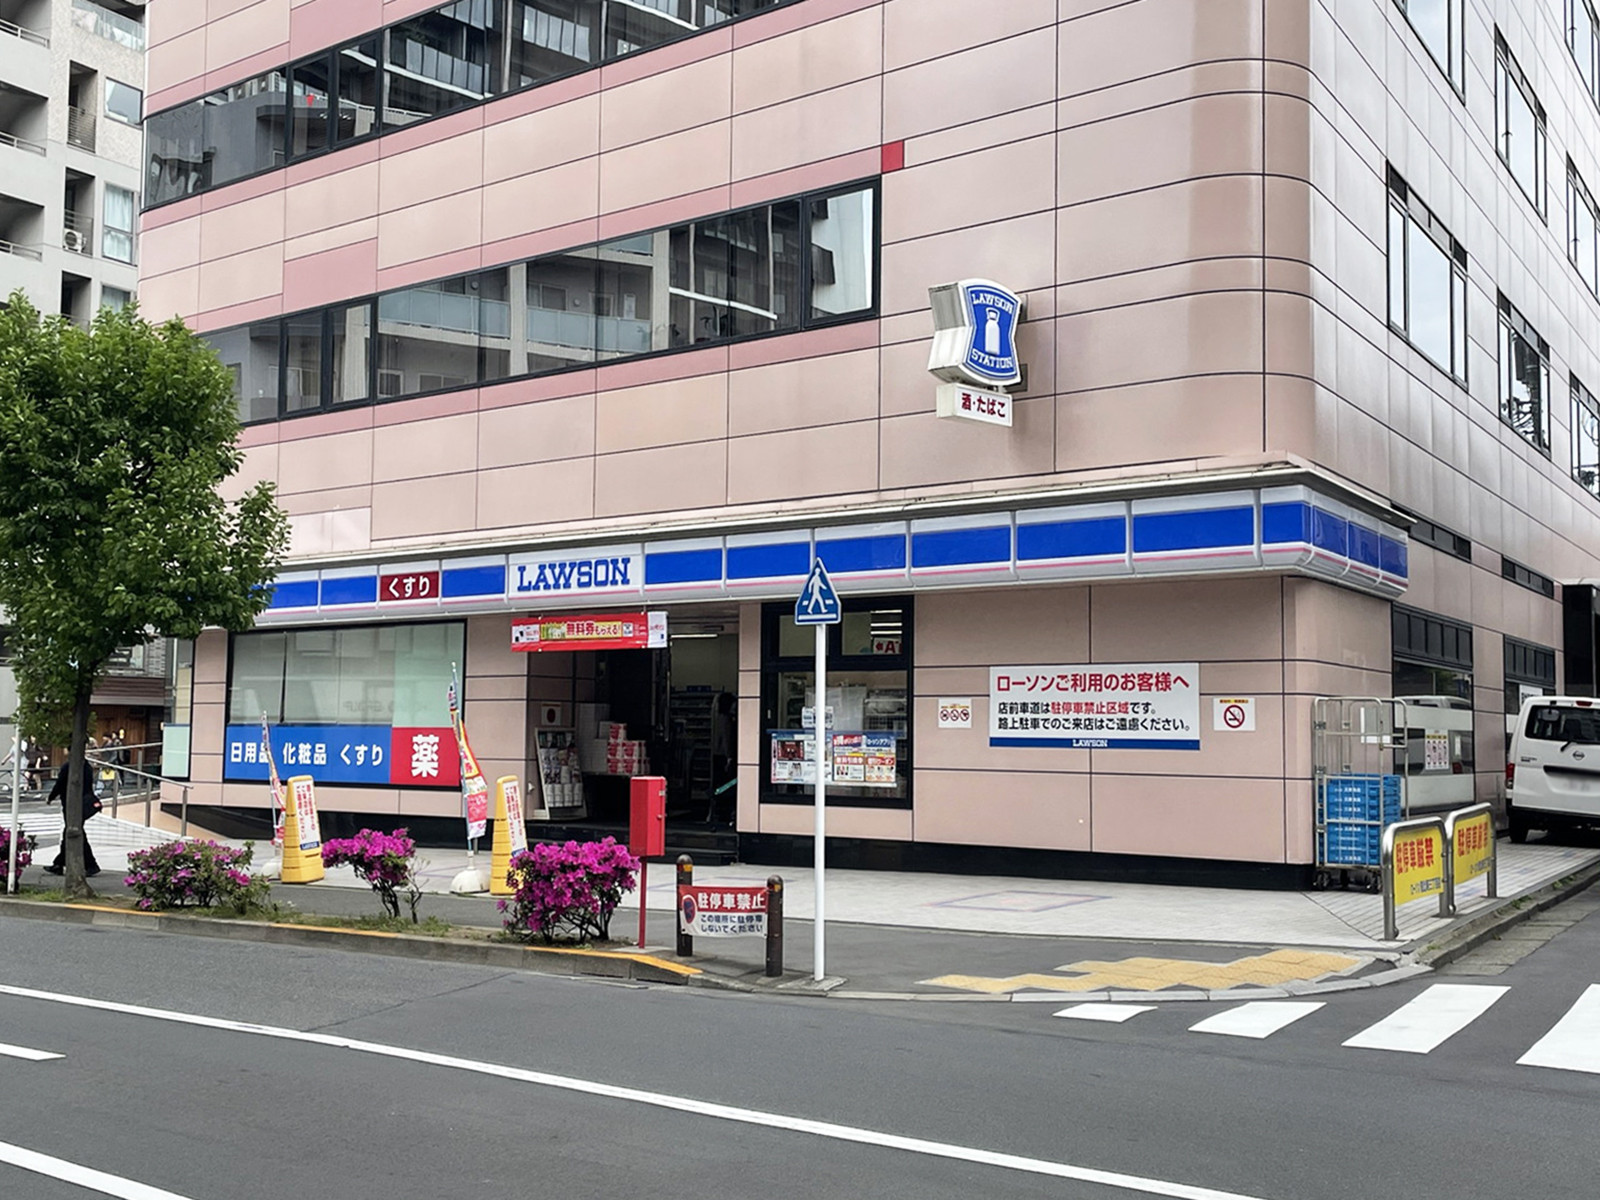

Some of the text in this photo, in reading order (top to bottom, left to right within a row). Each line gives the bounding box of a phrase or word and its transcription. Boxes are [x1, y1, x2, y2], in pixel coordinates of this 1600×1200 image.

[971, 293, 1014, 315] LAWSON
[971, 348, 1014, 369] STATION
[517, 557, 631, 592] LAWSON
[388, 576, 431, 598] くすり
[997, 672, 1190, 693] ローソンご利用のお客様へ
[998, 702, 1156, 715] 店前車道は駐停車禁止区域です。
[998, 717, 1190, 731] 路上駐車でのご来店はご遠慮ください。
[282, 742, 327, 765] 化粧品
[340, 744, 383, 766] くすり
[411, 734, 440, 777] 薬
[697, 892, 766, 910] 駐停車禁止
